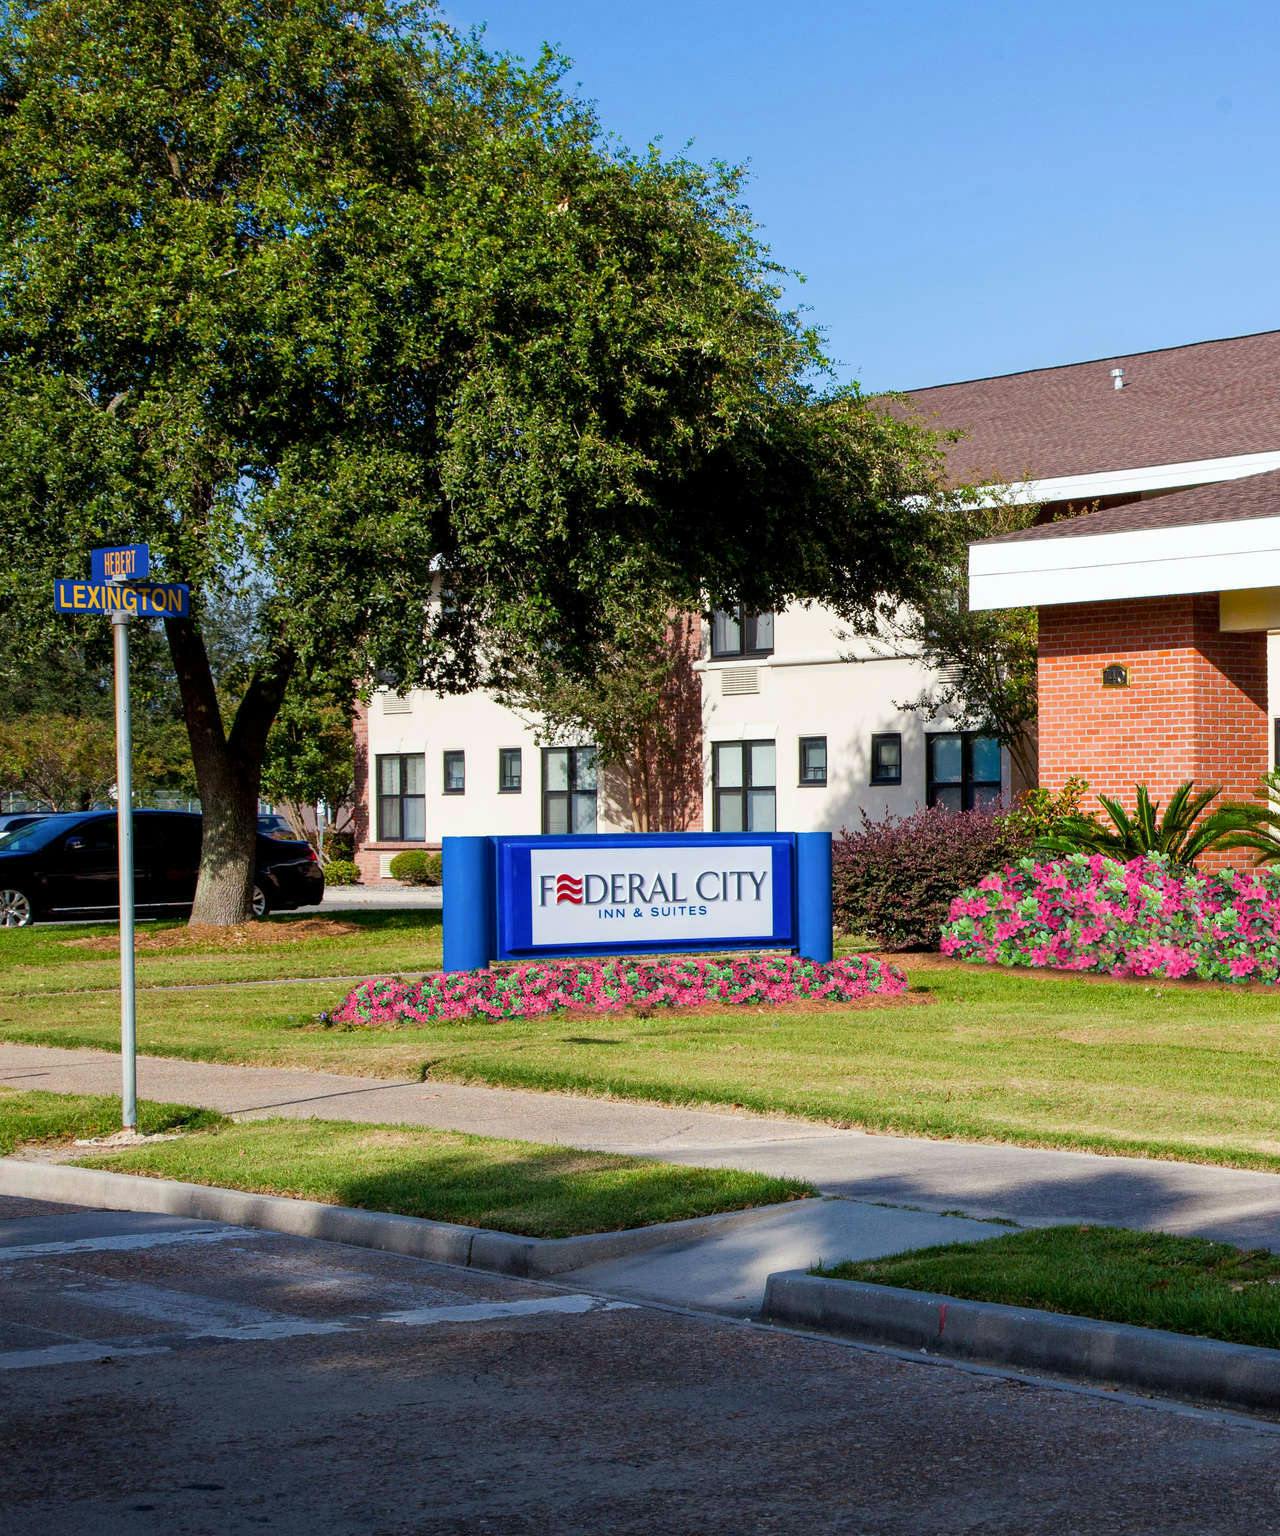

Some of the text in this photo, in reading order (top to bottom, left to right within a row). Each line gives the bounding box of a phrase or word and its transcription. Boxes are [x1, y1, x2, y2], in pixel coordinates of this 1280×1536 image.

[104, 551, 136, 576] HEBERT
[60, 584, 182, 612] LEXINGTON
[696, 871, 767, 902] CITY
[599, 905, 707, 919] INN & SUITES
